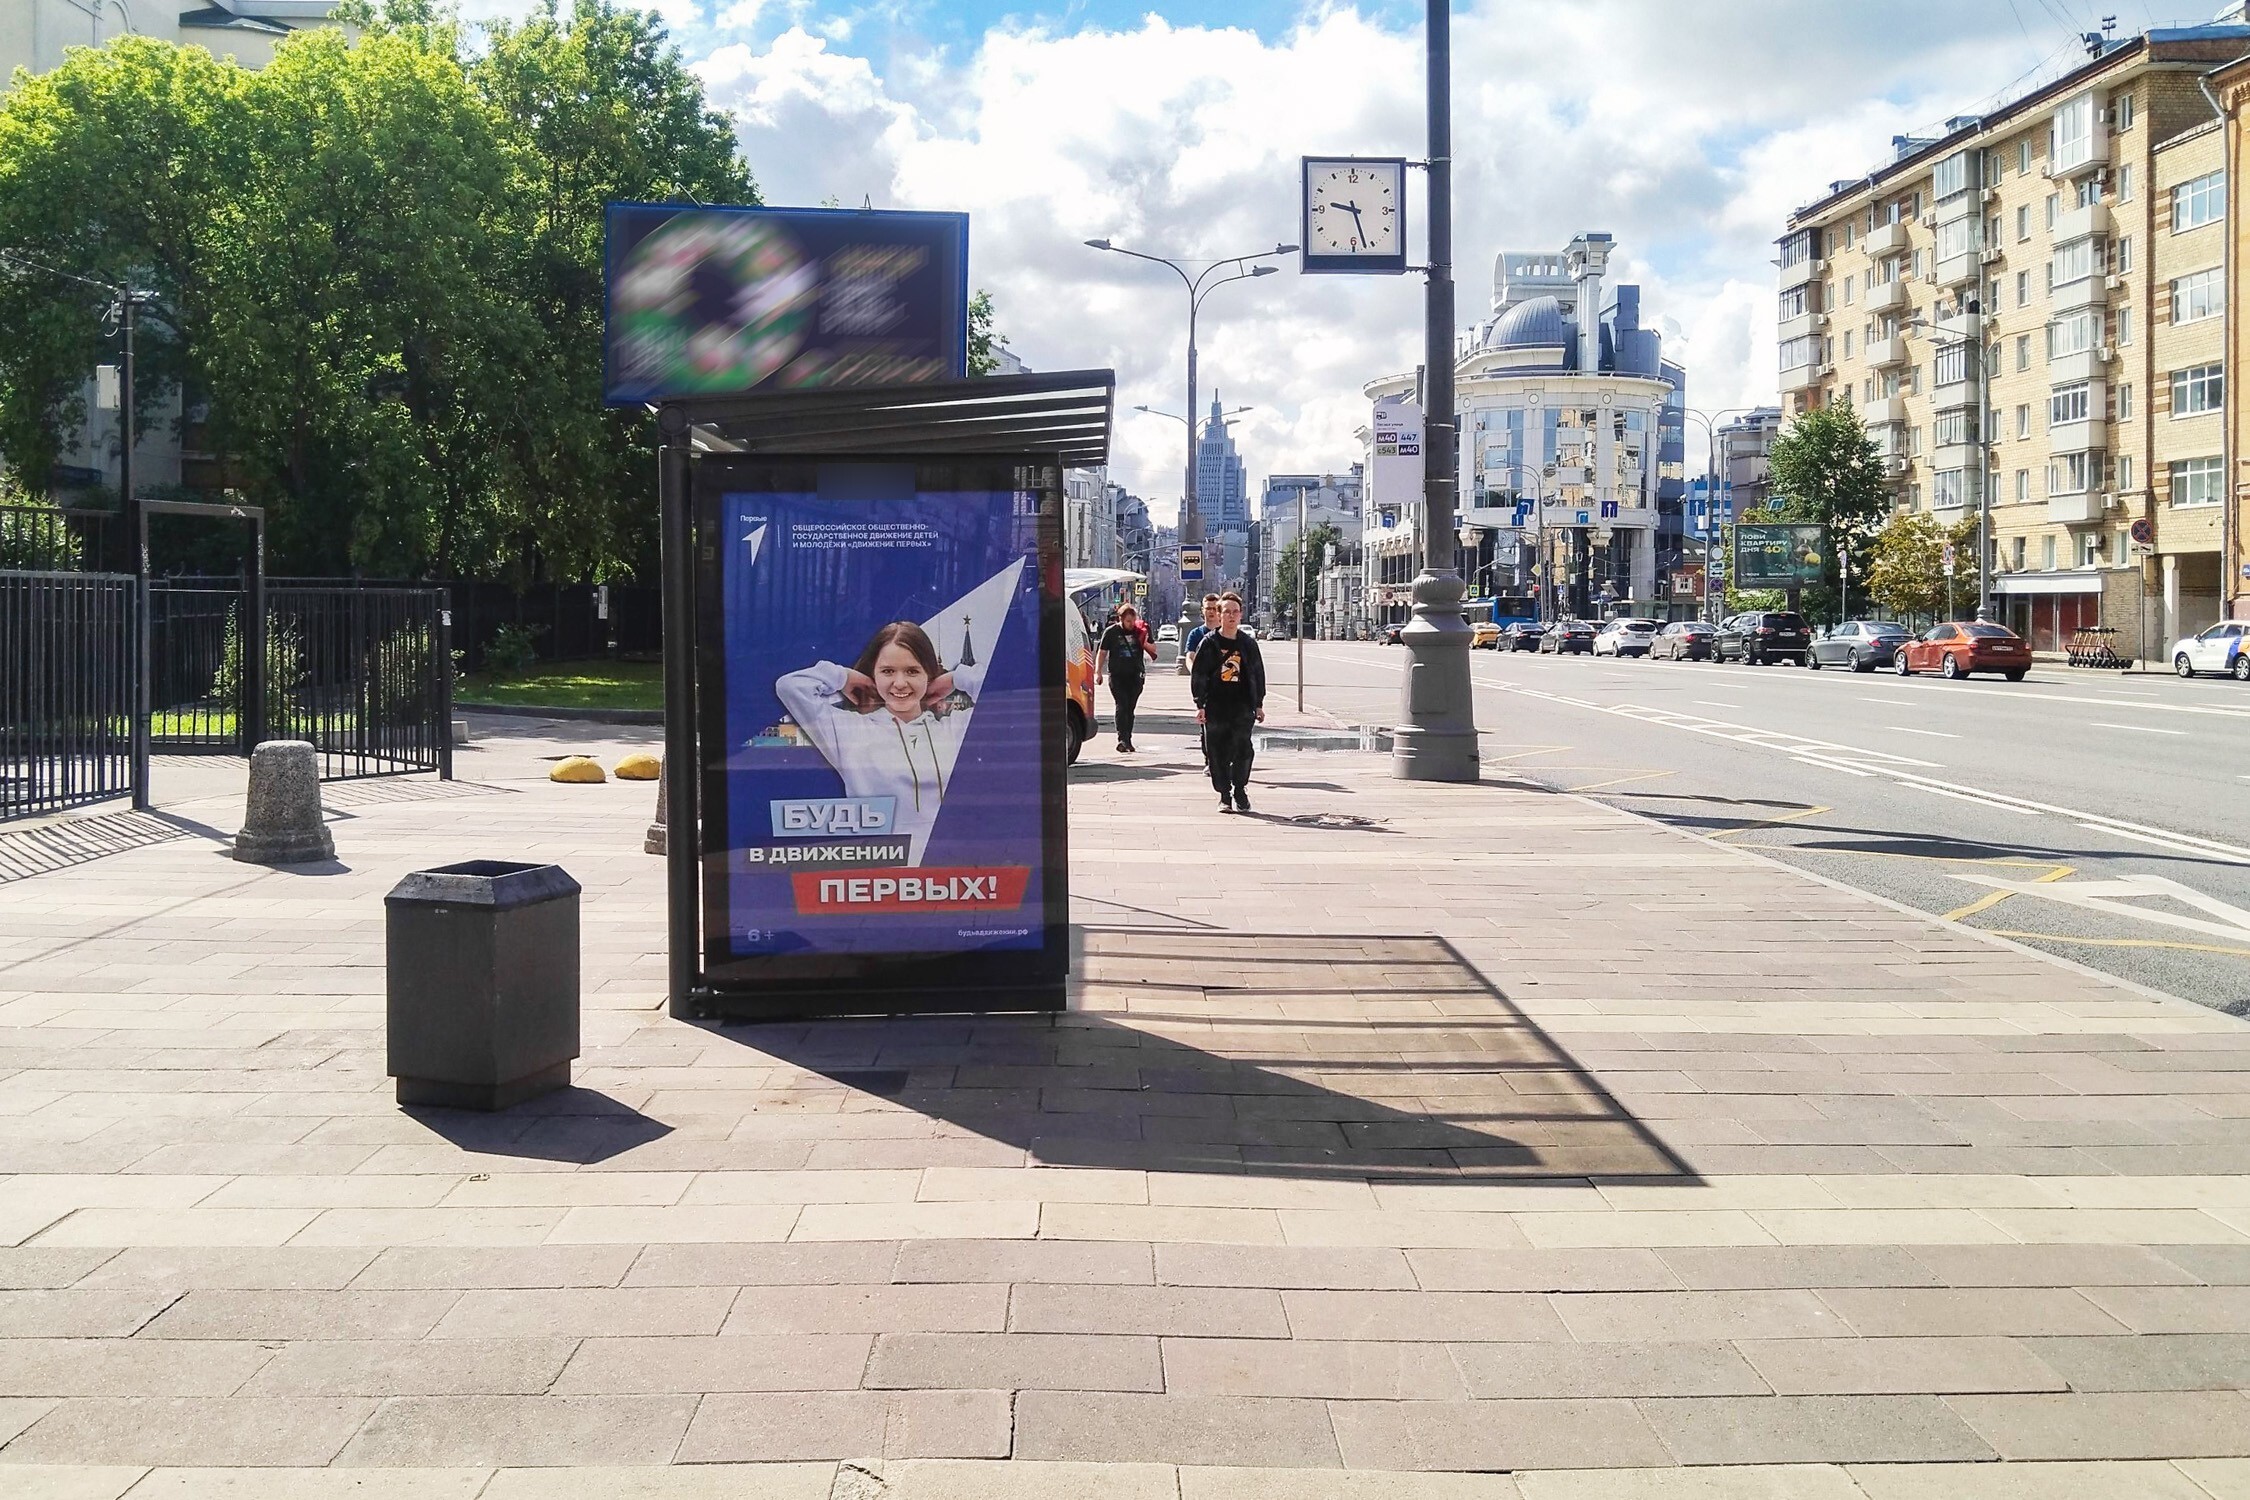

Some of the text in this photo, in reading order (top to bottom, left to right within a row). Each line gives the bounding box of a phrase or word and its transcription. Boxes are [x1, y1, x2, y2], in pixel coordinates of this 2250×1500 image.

[1348, 175, 1359, 184] 12
[1318, 205, 1325, 214] 9
[1382, 206, 1389, 215] 3
[1350, 237, 1357, 246] 6
[792, 523, 929, 532] ОБЩЕРОССИЙСКОЕ ОБЩЕСТВЕННО-
[792, 530, 939, 540] ГОСУДАРСТВЕННОЕ ДВИЖЕНИЕ ДЕТЕЙ
[799, 539, 847, 549] МОЛОДЁЖИ
[848, 540, 895, 549] «ДВИЖЕНИЕ
[896, 540, 932, 548] ПЕРВЫХ»
[783, 803, 887, 834] БУДЬ
[749, 845, 905, 864] В ДВИЖЕНИИ
[819, 875, 998, 903] ПЕРВЫХ!
